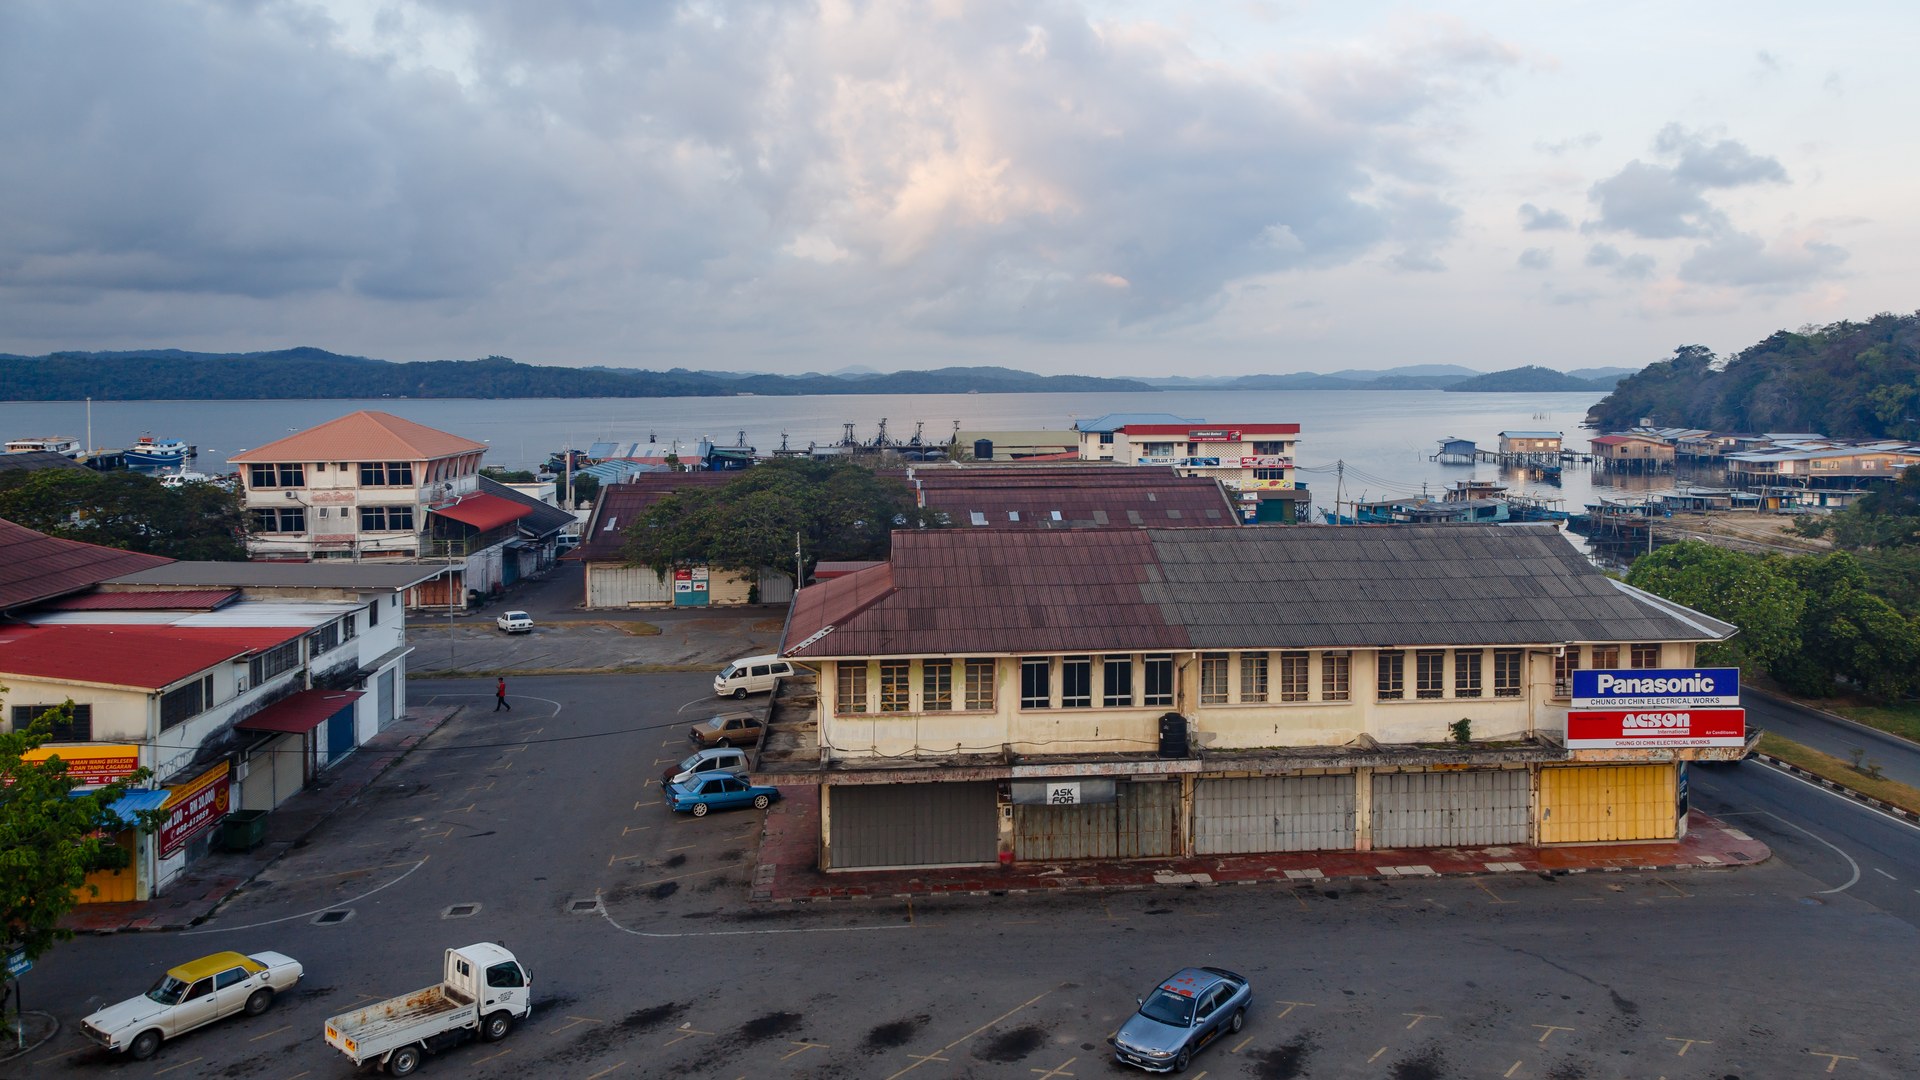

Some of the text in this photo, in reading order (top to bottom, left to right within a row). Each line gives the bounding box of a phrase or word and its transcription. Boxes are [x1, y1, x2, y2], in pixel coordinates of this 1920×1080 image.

[1597, 673, 1715, 694] Panasonic
[1590, 698, 1616, 706] CHUNG
[1646, 697, 1691, 705] ELECTRICAL
[1052, 788, 1074, 796] ASK
[1052, 796, 1074, 804] FOR
[189, 799, 198, 815] RM
